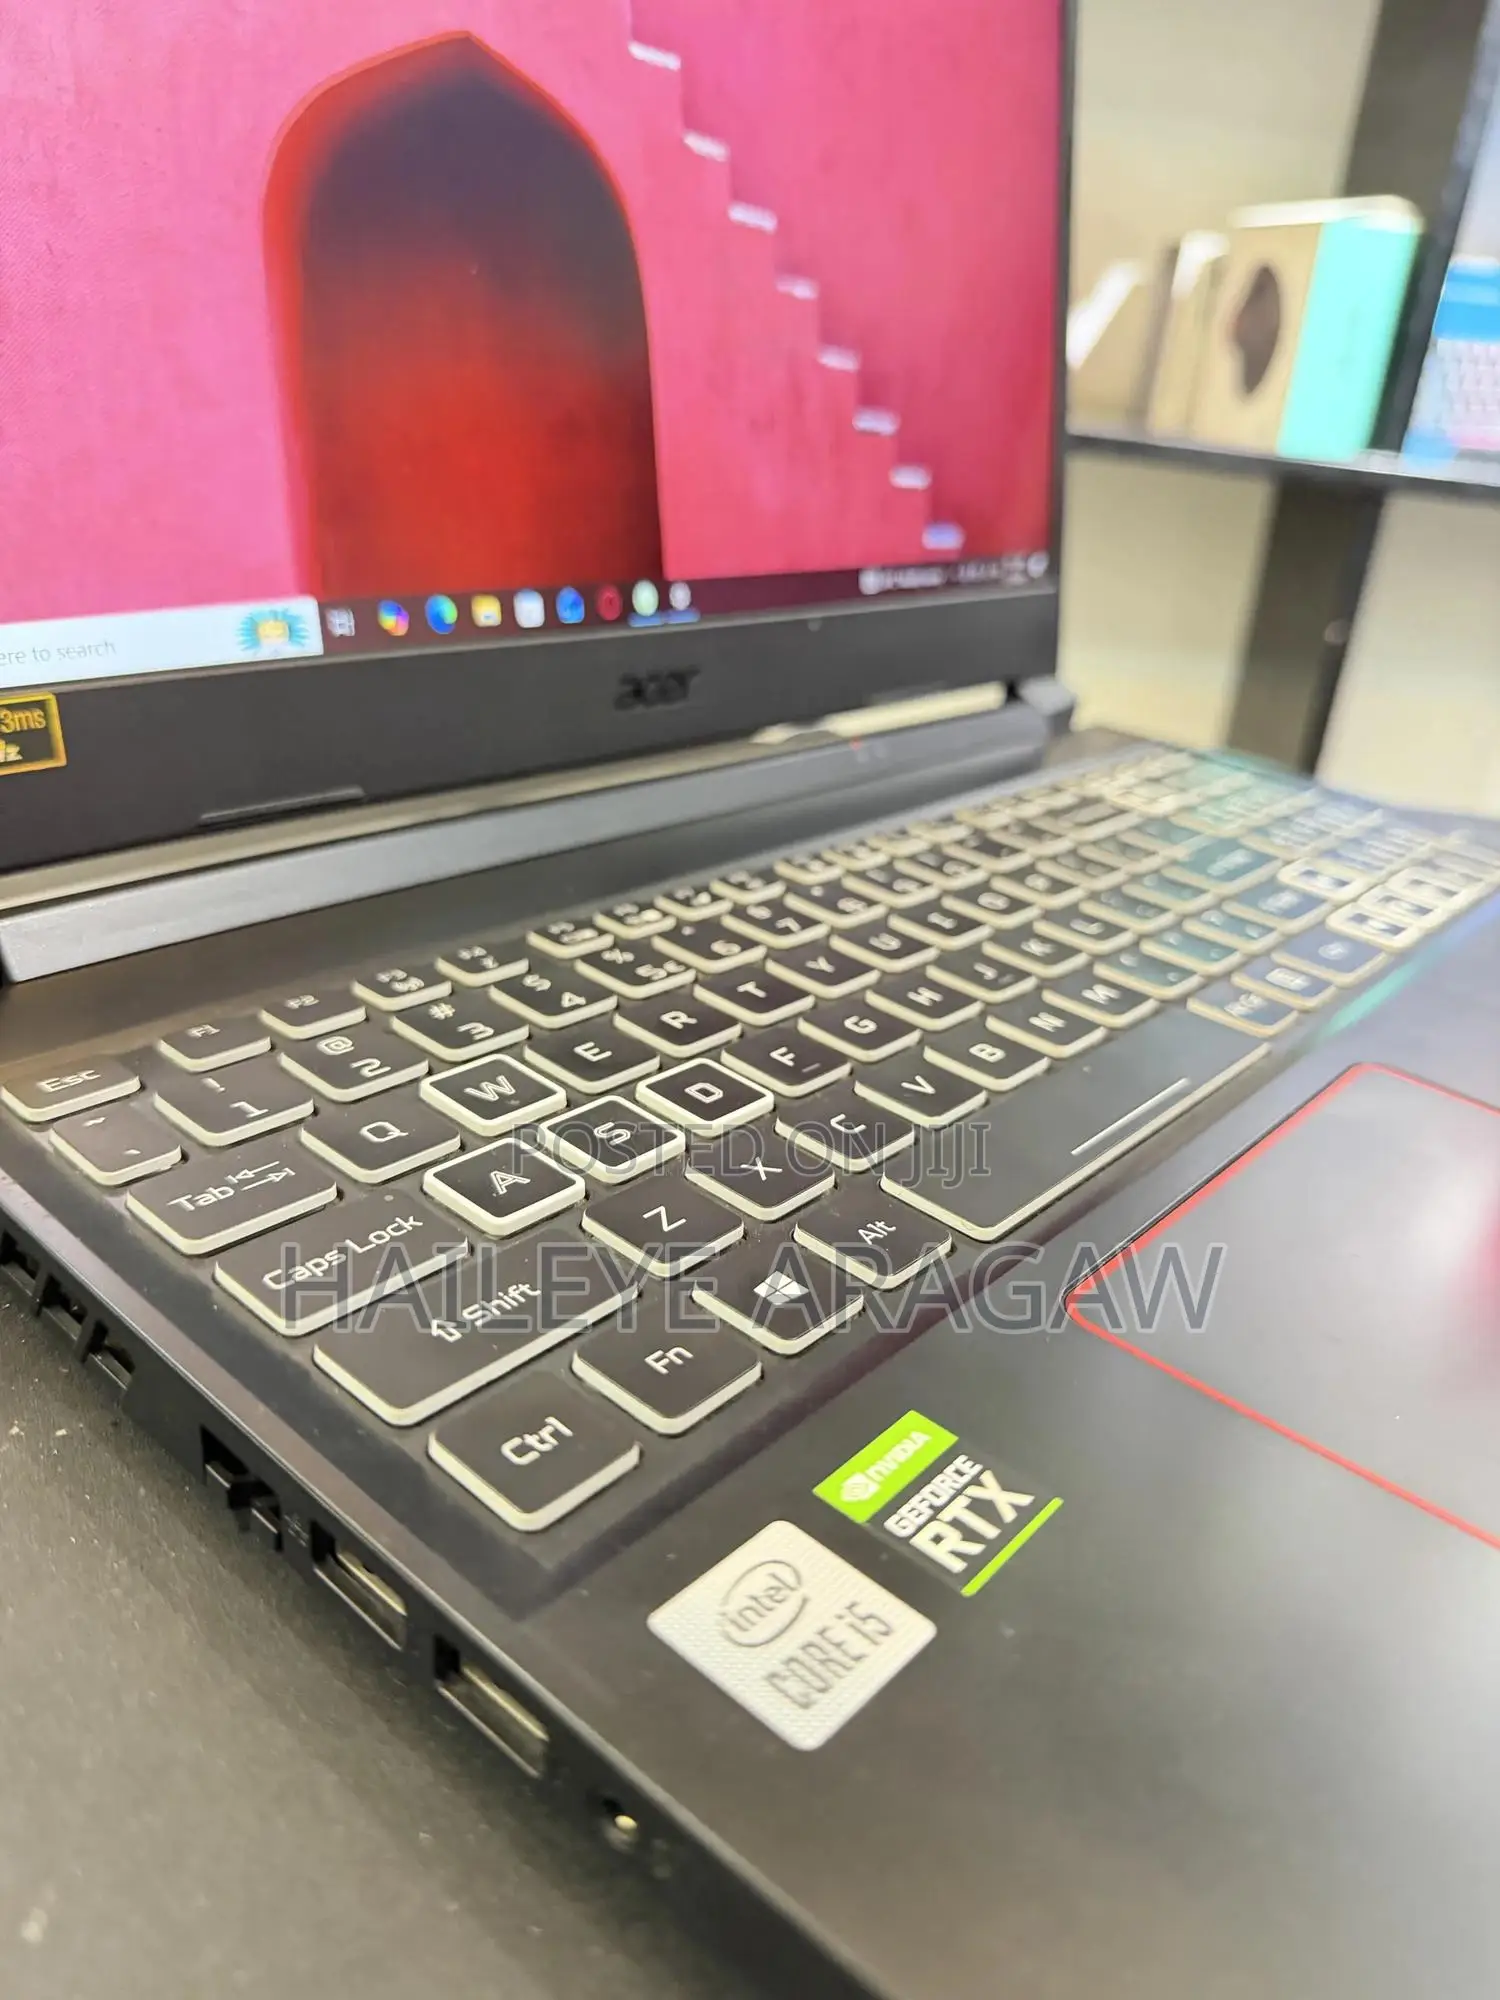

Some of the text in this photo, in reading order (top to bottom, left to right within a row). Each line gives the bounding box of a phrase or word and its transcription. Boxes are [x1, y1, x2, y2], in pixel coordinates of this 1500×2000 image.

[32, 646, 51, 662] to
[56, 640, 117, 661] search
[805, 956, 835, 973] Y
[737, 980, 767, 999] T
[907, 986, 943, 1006] H
[457, 1021, 494, 1041] 3
[660, 1010, 698, 1029] R
[843, 1015, 877, 1034] G
[315, 1035, 356, 1056] @
[573, 1041, 612, 1062] E
[769, 1046, 797, 1067] F
[969, 1042, 1006, 1062] B
[350, 1057, 392, 1079] 2
[36, 1069, 100, 1092] Esc
[463, 1074, 517, 1102] W
[901, 1074, 936, 1095] V
[684, 1081, 724, 1104] D
[229, 1100, 269, 1118] 1
[359, 1120, 409, 1143] Q
[593, 1121, 631, 1146] S
[740, 1156, 783, 1181] X
[488, 1167, 532, 1196] A
[167, 1184, 236, 1213] Tab
[642, 1205, 687, 1232] Z
[857, 1218, 896, 1245] Alt
[262, 1213, 424, 1292] Caps Lock
[462, 1281, 542, 1328] Shift
[643, 1343, 694, 1376] Fn
[500, 1415, 575, 1466] Ctrl
[883, 1454, 984, 1538] GEFORCE
[909, 1469, 1036, 1574] RTX
[719, 1573, 801, 1632] intel
[764, 1601, 894, 1710] CORE i5
